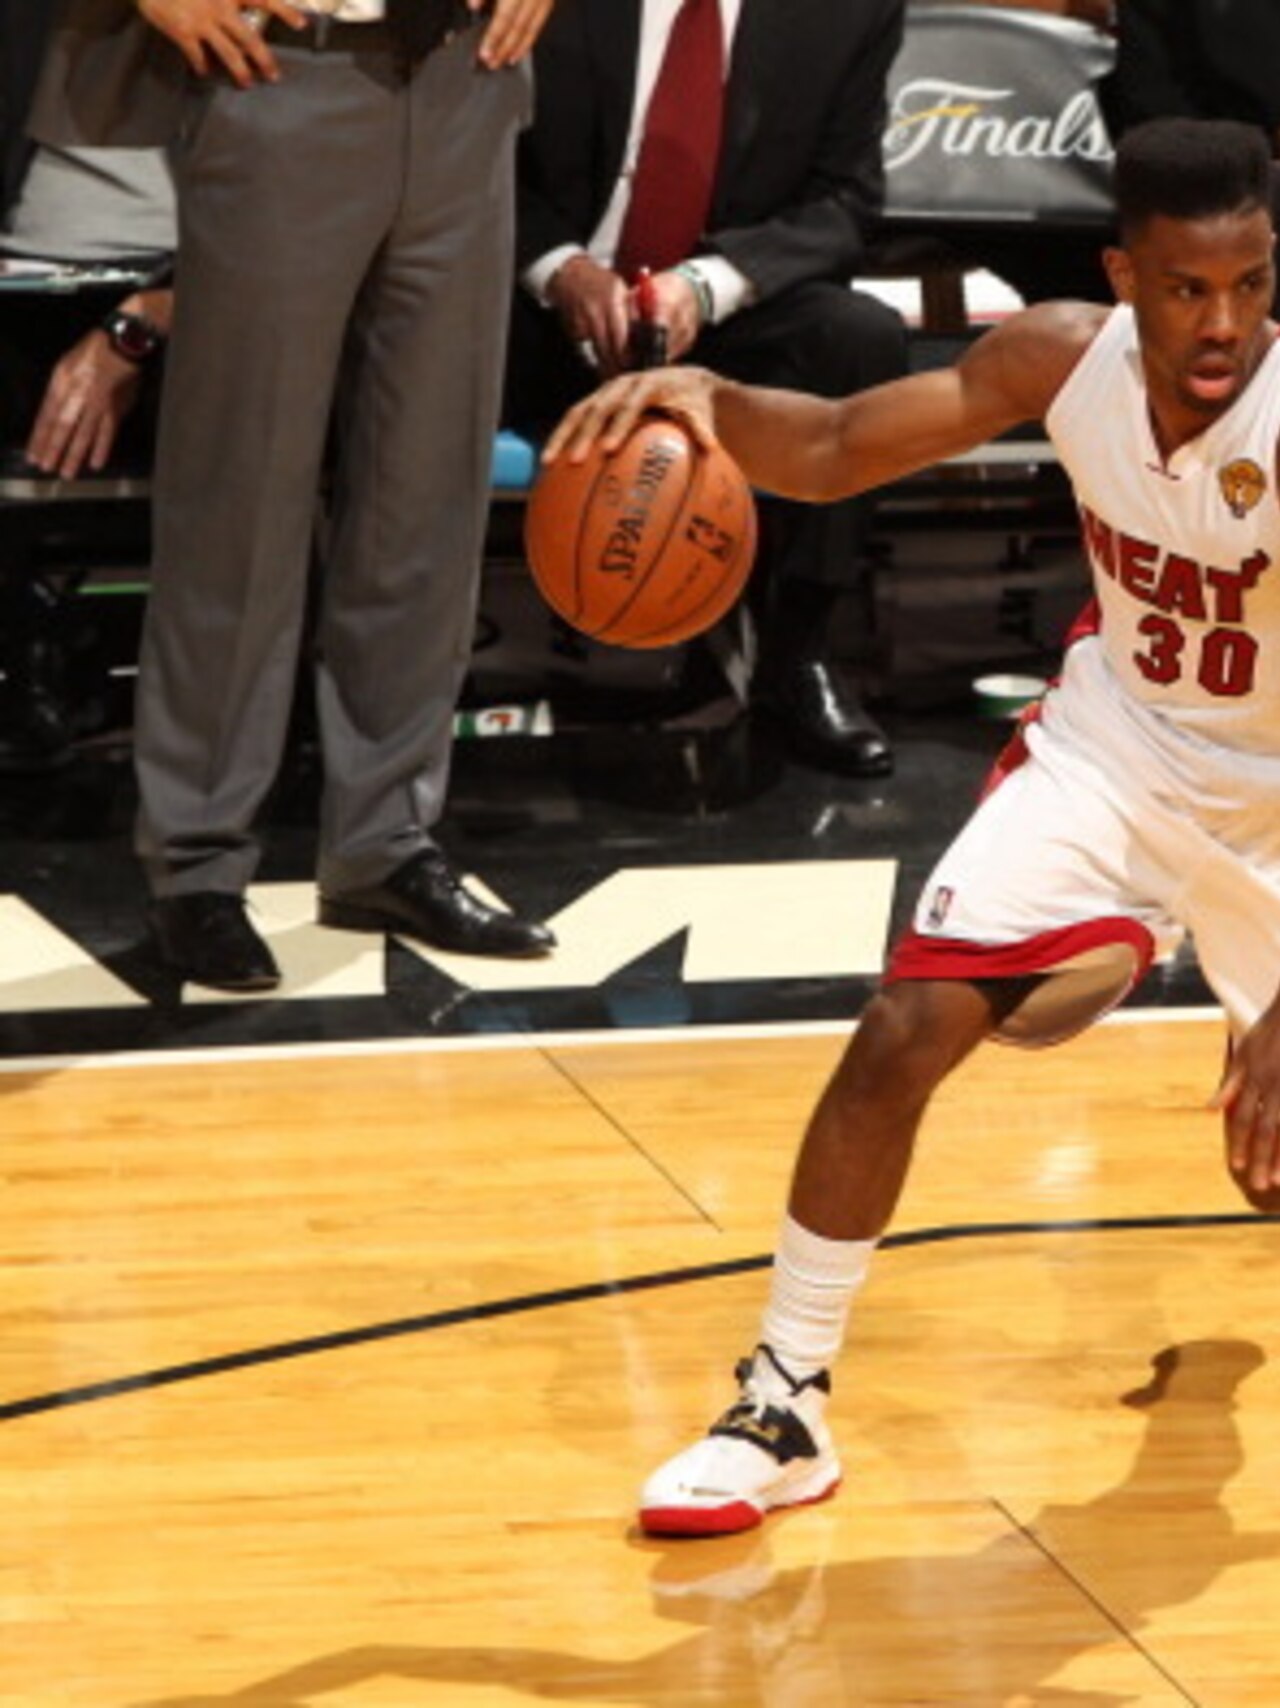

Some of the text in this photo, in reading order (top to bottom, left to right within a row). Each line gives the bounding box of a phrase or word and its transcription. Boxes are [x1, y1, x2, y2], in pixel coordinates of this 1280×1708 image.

[881, 77, 1117, 170] Finals
[1082, 502, 1271, 624] HEAT
[1132, 612, 1259, 698] 30
